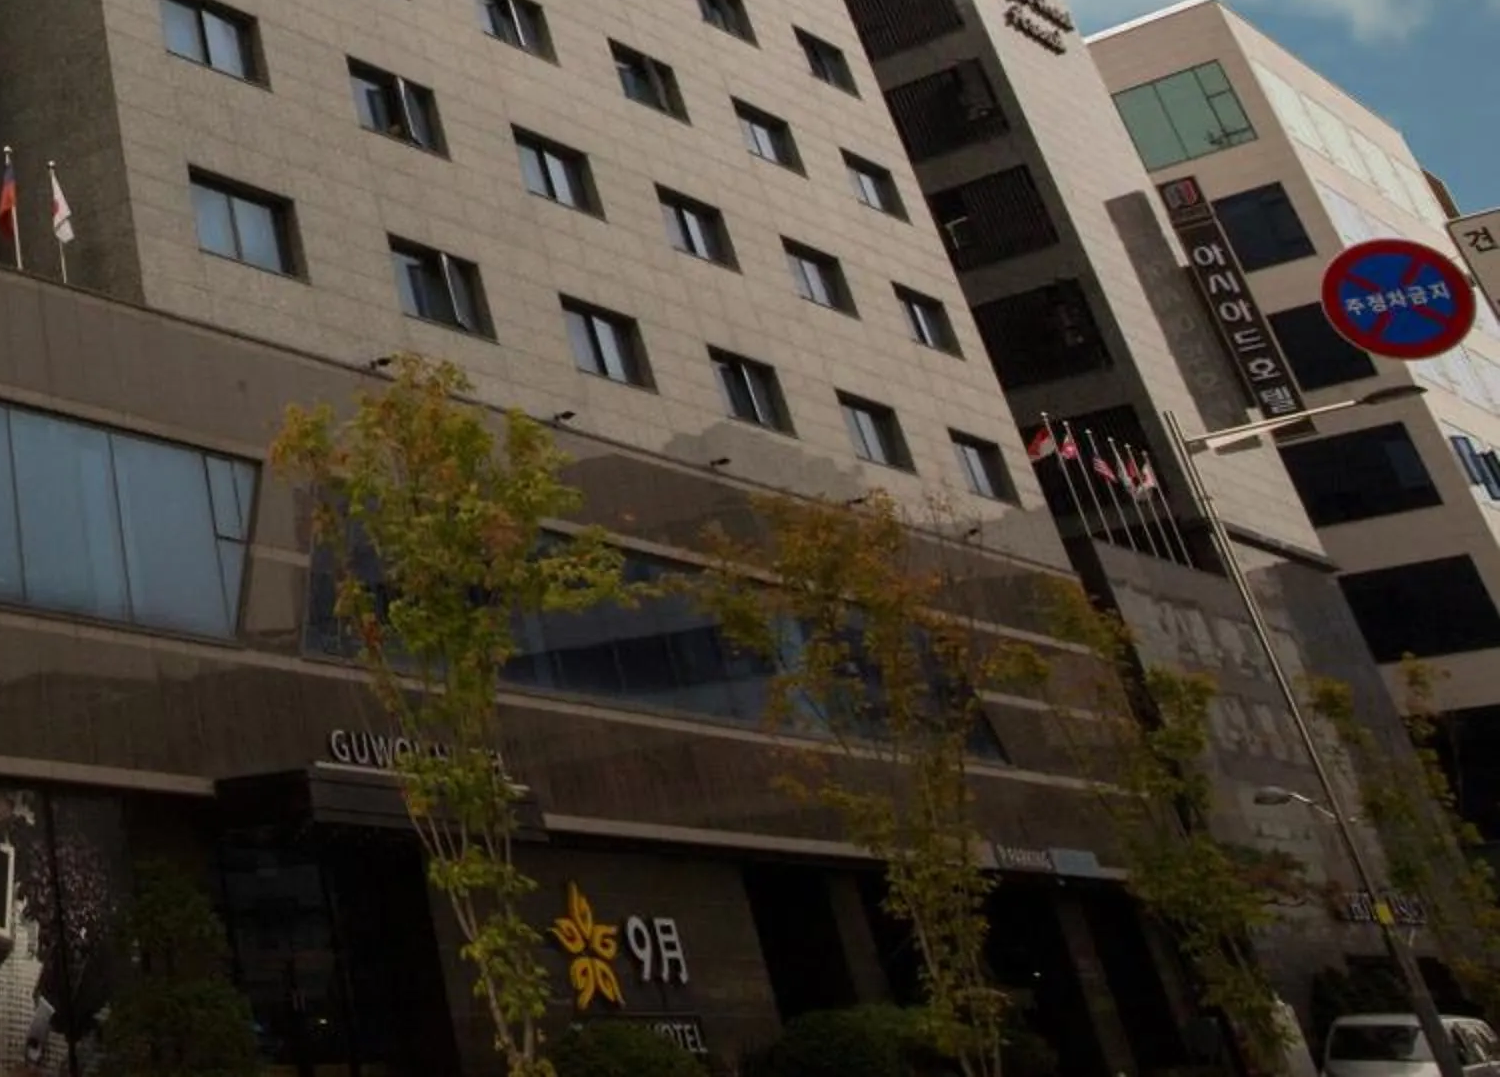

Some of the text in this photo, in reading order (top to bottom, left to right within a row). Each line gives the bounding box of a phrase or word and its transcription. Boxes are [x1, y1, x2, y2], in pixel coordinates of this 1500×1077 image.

[1345, 280, 1450, 316] 주정차금지
[626, 913, 690, 985] 9月
[650, 1022, 709, 1054] OTEL
